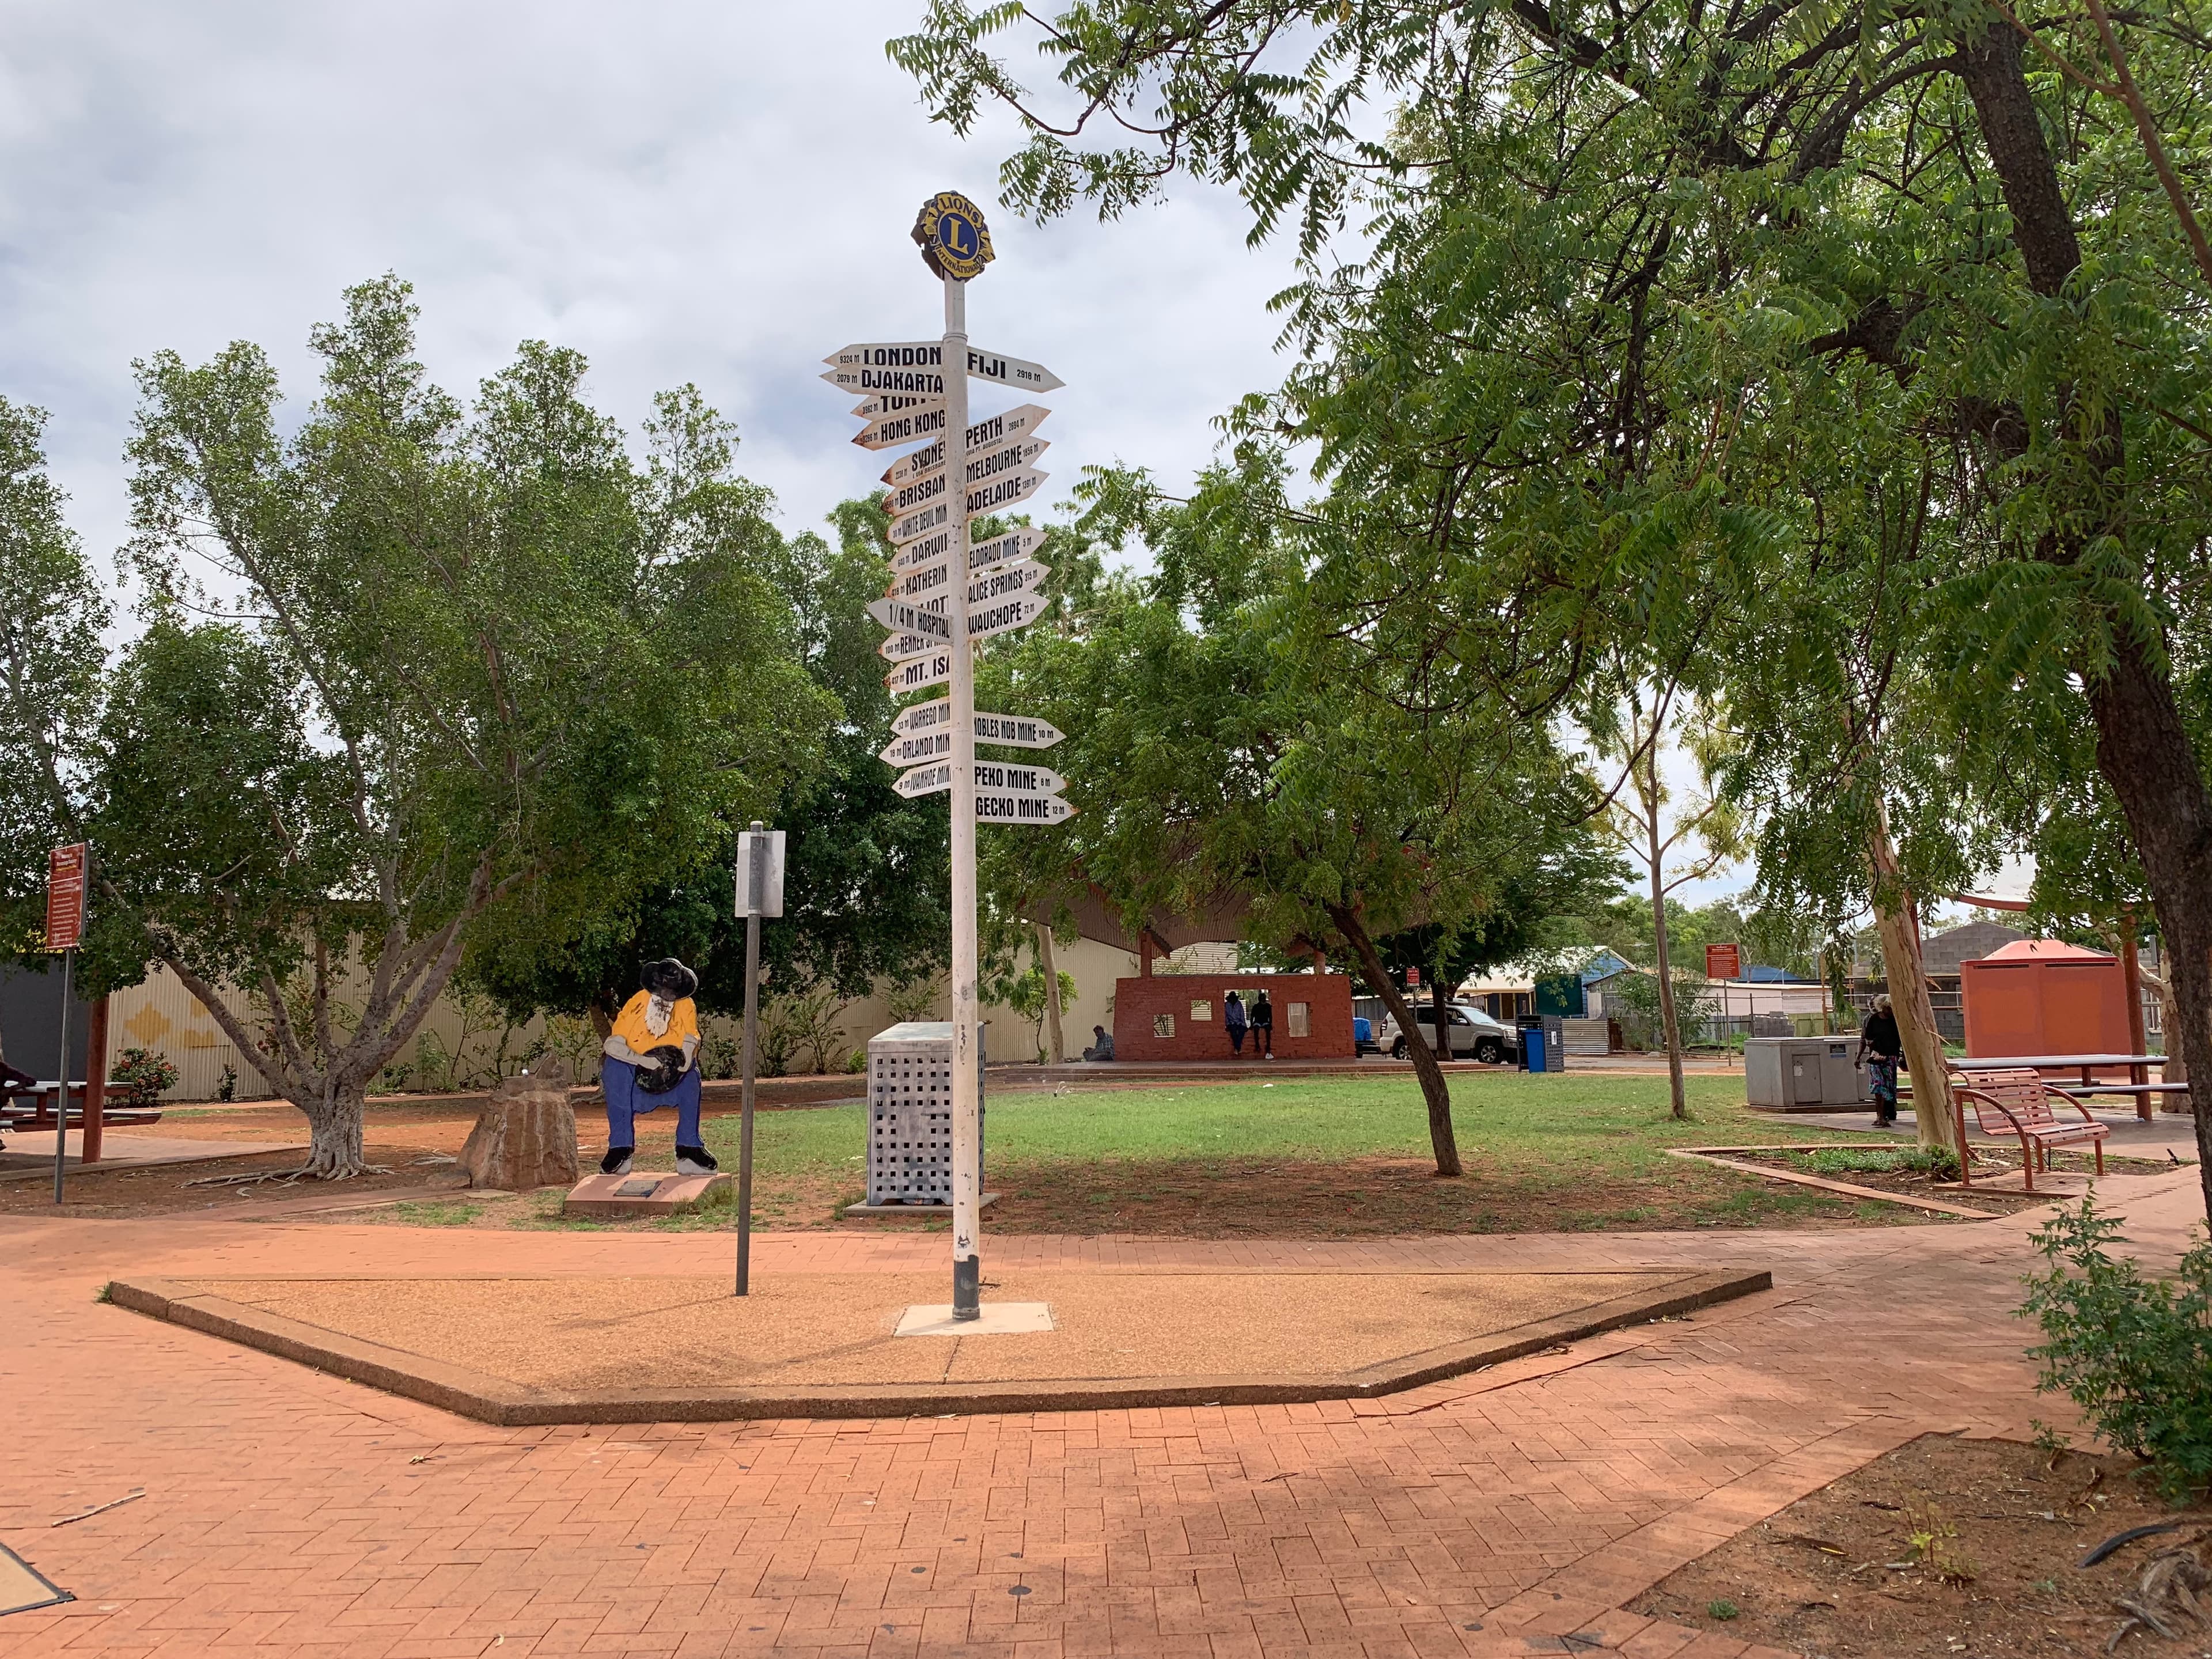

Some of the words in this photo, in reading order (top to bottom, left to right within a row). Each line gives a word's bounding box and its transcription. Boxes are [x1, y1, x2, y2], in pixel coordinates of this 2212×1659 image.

[939, 196, 980, 224] LIONS
[947, 217, 969, 255] L
[934, 247, 982, 274] INTERNATIONAL
[840, 355, 853, 364] 9324
[864, 346, 942, 366] LONDON
[968, 351, 1006, 379] FIJI
[1017, 369, 1032, 380] 2918
[837, 374, 850, 382] 2079
[861, 369, 944, 393] DJAKARTA
[881, 418, 911, 443] HONG
[915, 409, 945, 434] KONG
[965, 416, 1003, 449] PERTH
[1008, 421, 1019, 431] 2694
[966, 444, 1022, 483] MELBOURNE
[1023, 448, 1033, 457] 1856
[900, 474, 945, 508] BRISBAN
[967, 476, 1021, 513] ADELAIDE
[1022, 478, 1031, 490] 1391
[902, 514, 918, 538] WHITE
[919, 509, 934, 531] DEVIL
[935, 503, 947, 525] MIN
[912, 532, 948, 565] DARWI
[969, 541, 1001, 569] ELDORADO
[1003, 535, 1020, 559] MINE
[1023, 539, 1026, 547] 5
[906, 563, 947, 596] KATHERIN
[968, 580, 988, 604] ALICE
[990, 569, 1023, 597] SPRINGS
[907, 608, 914, 628] M
[918, 611, 950, 639] HOSPITAL
[968, 601, 1022, 635] WAUCHOPE
[1024, 605, 1029, 614] 72
[885, 645, 893, 654] 100
[906, 662, 928, 685] MT.
[898, 721, 904, 730] 33
[910, 706, 937, 730] WARREGO
[938, 702, 950, 723] MIN
[1001, 720, 1015, 740] NOB
[1017, 722, 1037, 742] MINE
[1039, 730, 1045, 738] 10
[890, 749, 895, 757] 18
[903, 736, 933, 759] ORLANDO
[935, 732, 950, 753] MIN
[910, 768, 936, 791] IVANHOE
[937, 764, 951, 785] MIN
[975, 766, 1003, 787] PEKO
[1007, 770, 1037, 790] MINE
[1041, 778, 1044, 786] 8
[976, 797, 1014, 817] GECKO
[1018, 798, 1049, 818] MINE
[1052, 806, 1058, 815] 12
